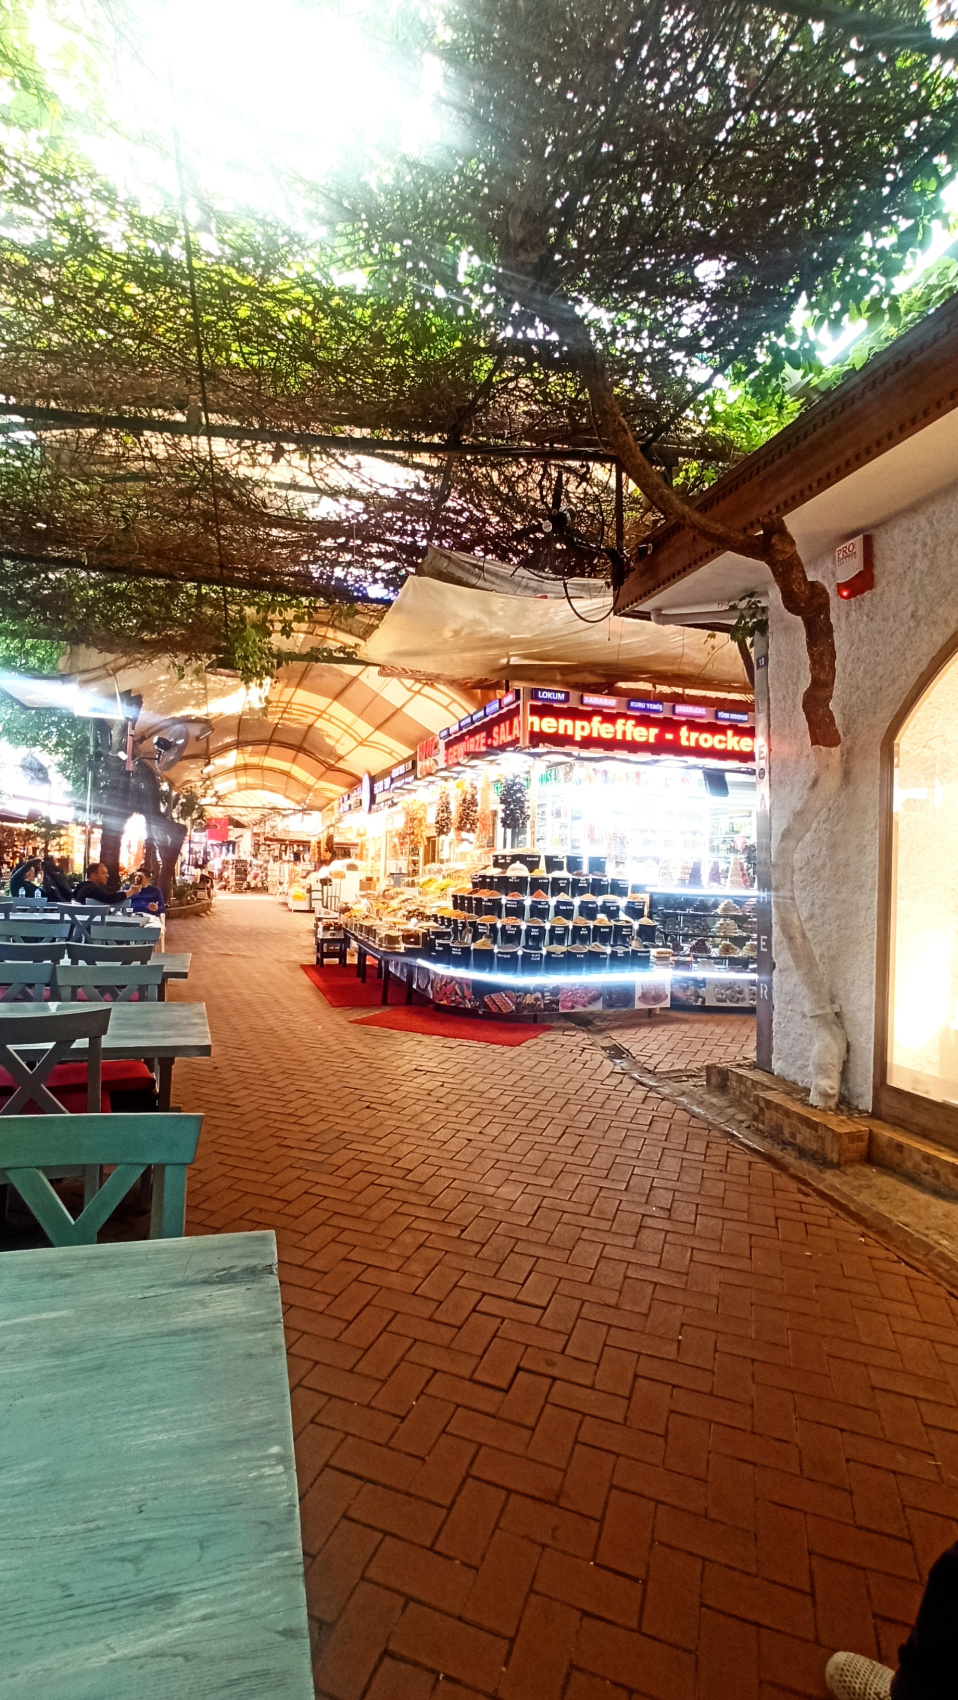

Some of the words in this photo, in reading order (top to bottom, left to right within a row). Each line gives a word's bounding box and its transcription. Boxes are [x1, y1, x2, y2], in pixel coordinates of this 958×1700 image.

[837, 542, 855, 560] PRO
[538, 690, 565, 701] LOKUM
[630, 701, 646, 709] KURU
[492, 715, 520, 747] SALA
